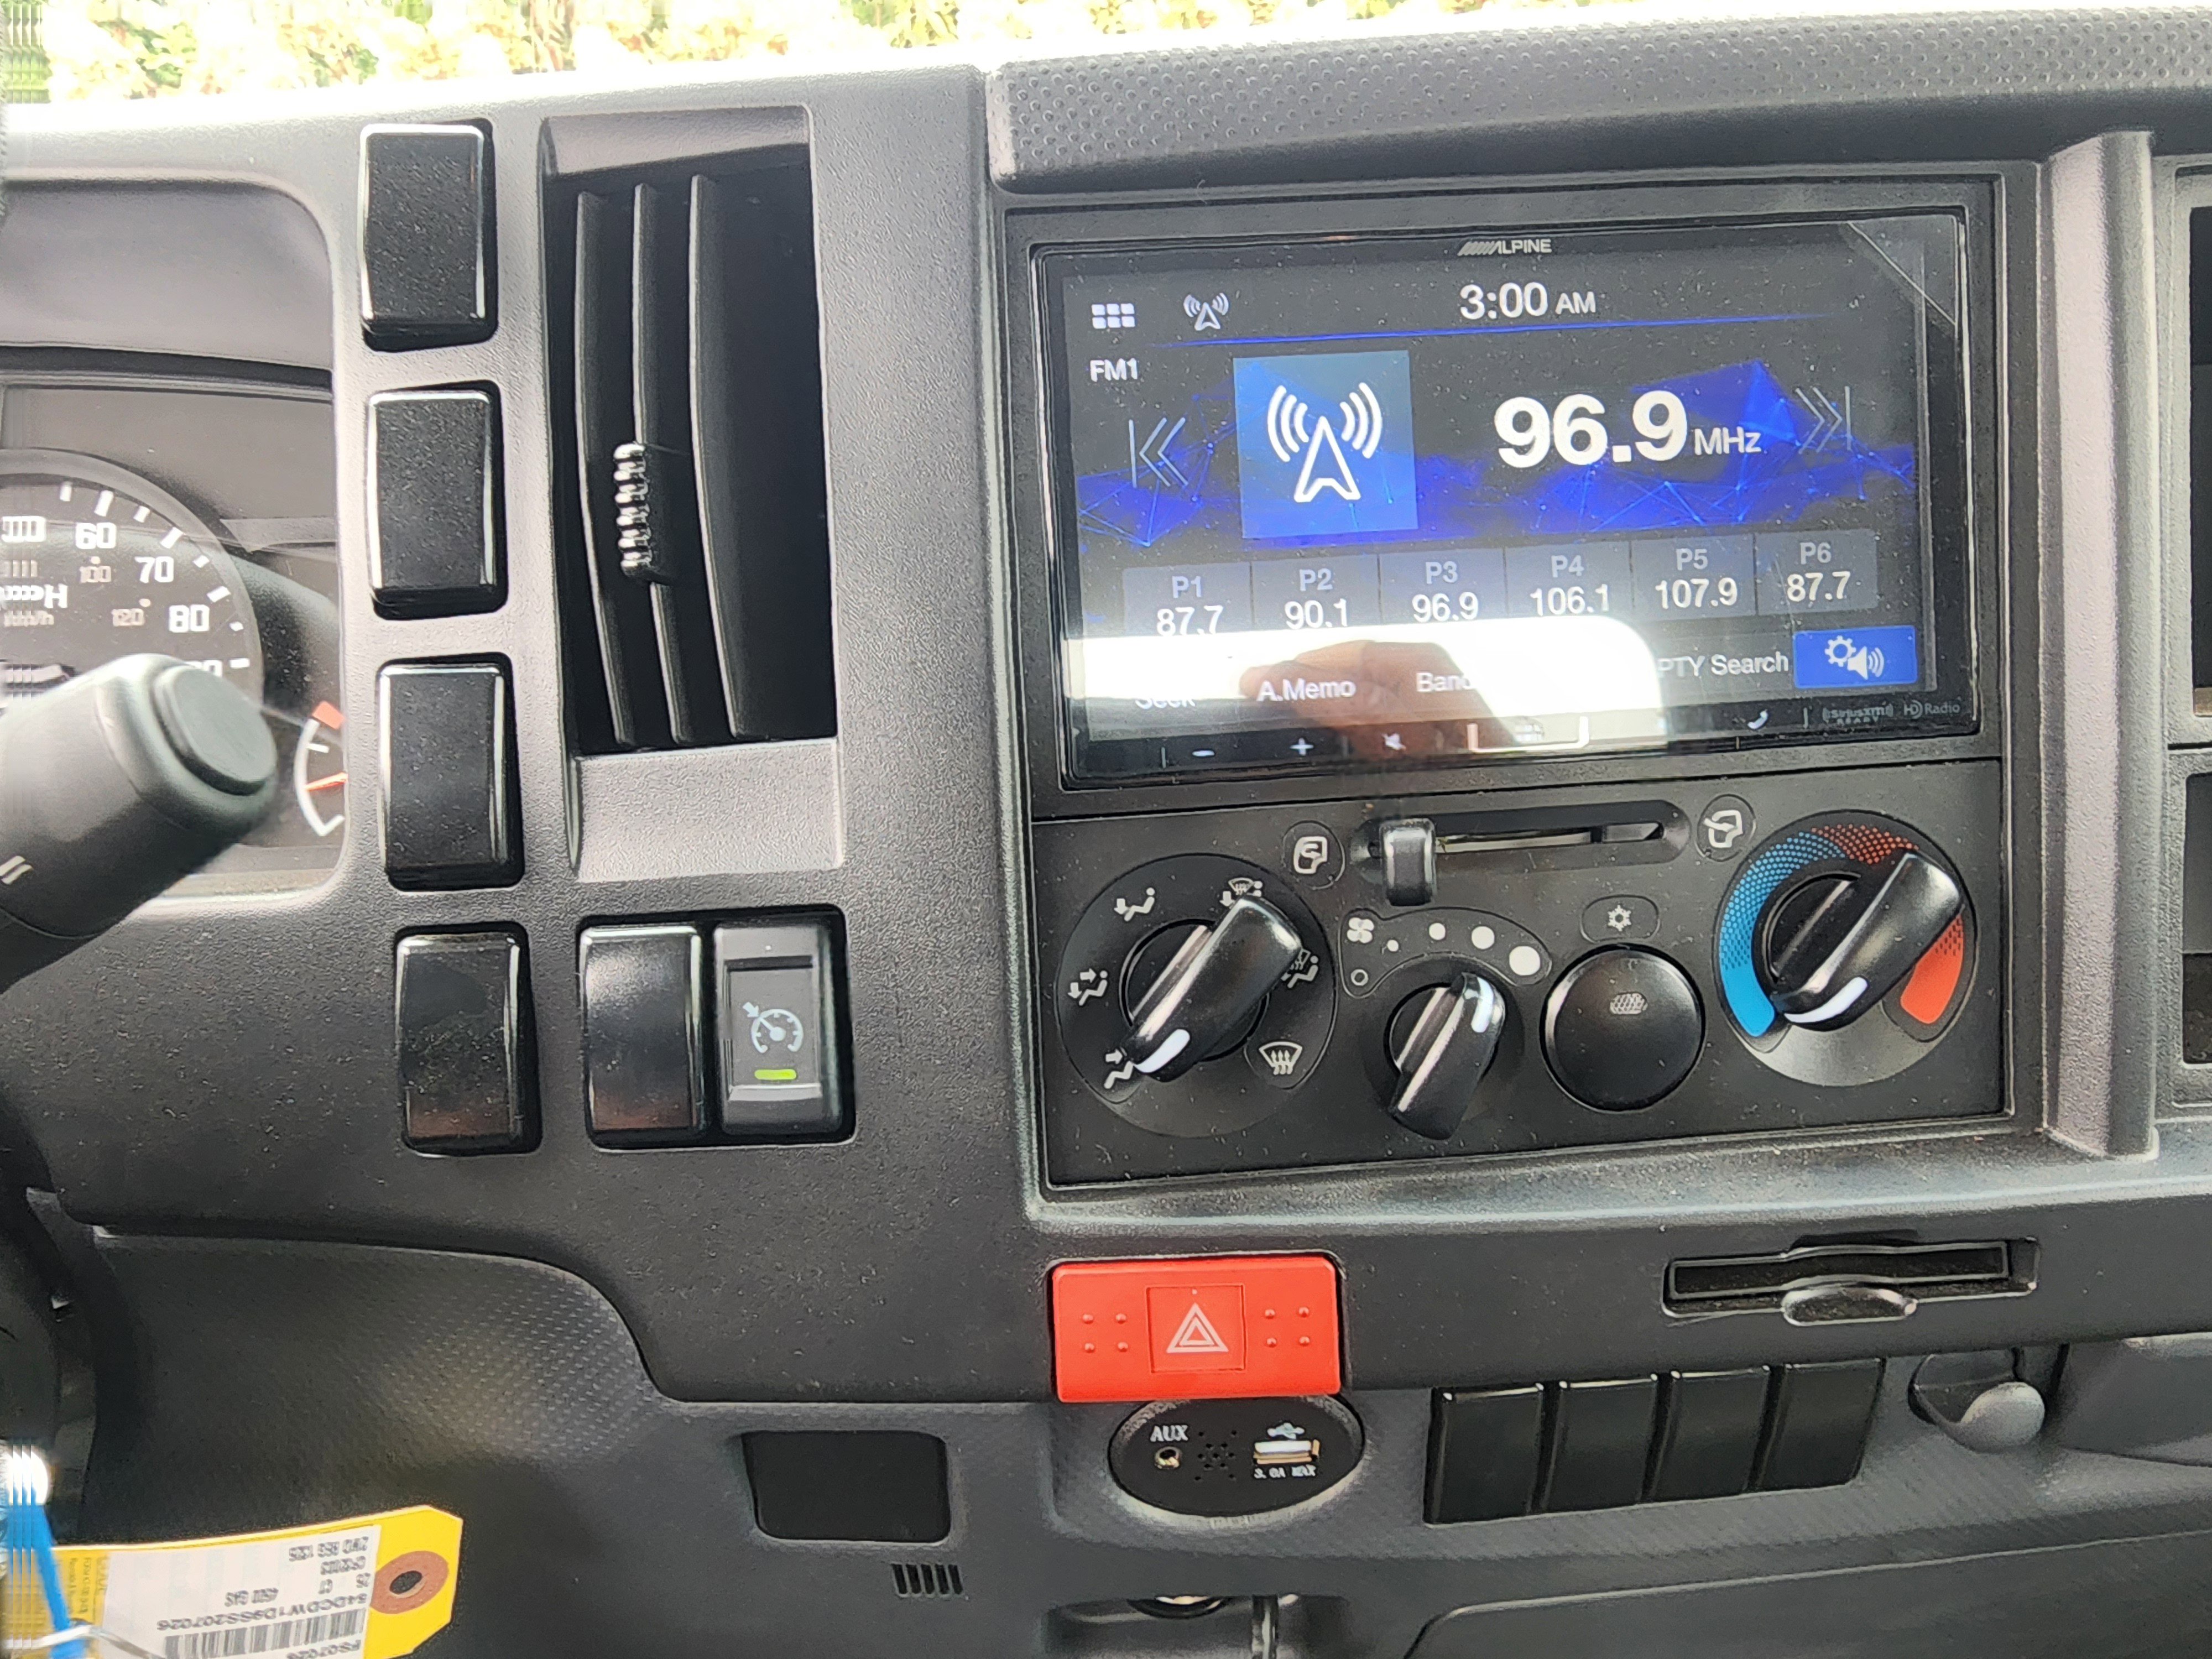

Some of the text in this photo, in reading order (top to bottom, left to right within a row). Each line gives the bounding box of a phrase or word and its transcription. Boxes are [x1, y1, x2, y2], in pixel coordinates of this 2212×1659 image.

[1488, 239, 1552, 255] ALPINE
[1459, 281, 1596, 319] 3:00 AM
[1090, 358, 1139, 382] FM1
[1494, 390, 1761, 468] 96.9 MHz
[75, 522, 116, 549] 60
[1676, 548, 1708, 571] P5
[1800, 542, 1832, 564] P6
[79, 566, 111, 583] 100
[135, 556, 174, 583] 70
[1426, 562, 1458, 584] P3
[1551, 555, 1584, 577] P4
[1172, 576, 1202, 598] P1
[1299, 568, 1332, 591] P2
[1787, 571, 1851, 602] 87.7
[1530, 584, 1610, 617] 106.1
[1656, 577, 1738, 609] 107.9
[112, 608, 144, 627] 120
[168, 604, 210, 633] 80
[1285, 598, 1348, 629] 90.1
[1412, 591, 1479, 622] 96.9
[1157, 606, 1223, 635] 87.7
[1657, 651, 1788, 677] PTY Search
[1257, 677, 1356, 702] A.Memo
[1924, 702, 1960, 714] Radio
[1150, 1425, 1189, 1442] AUX
